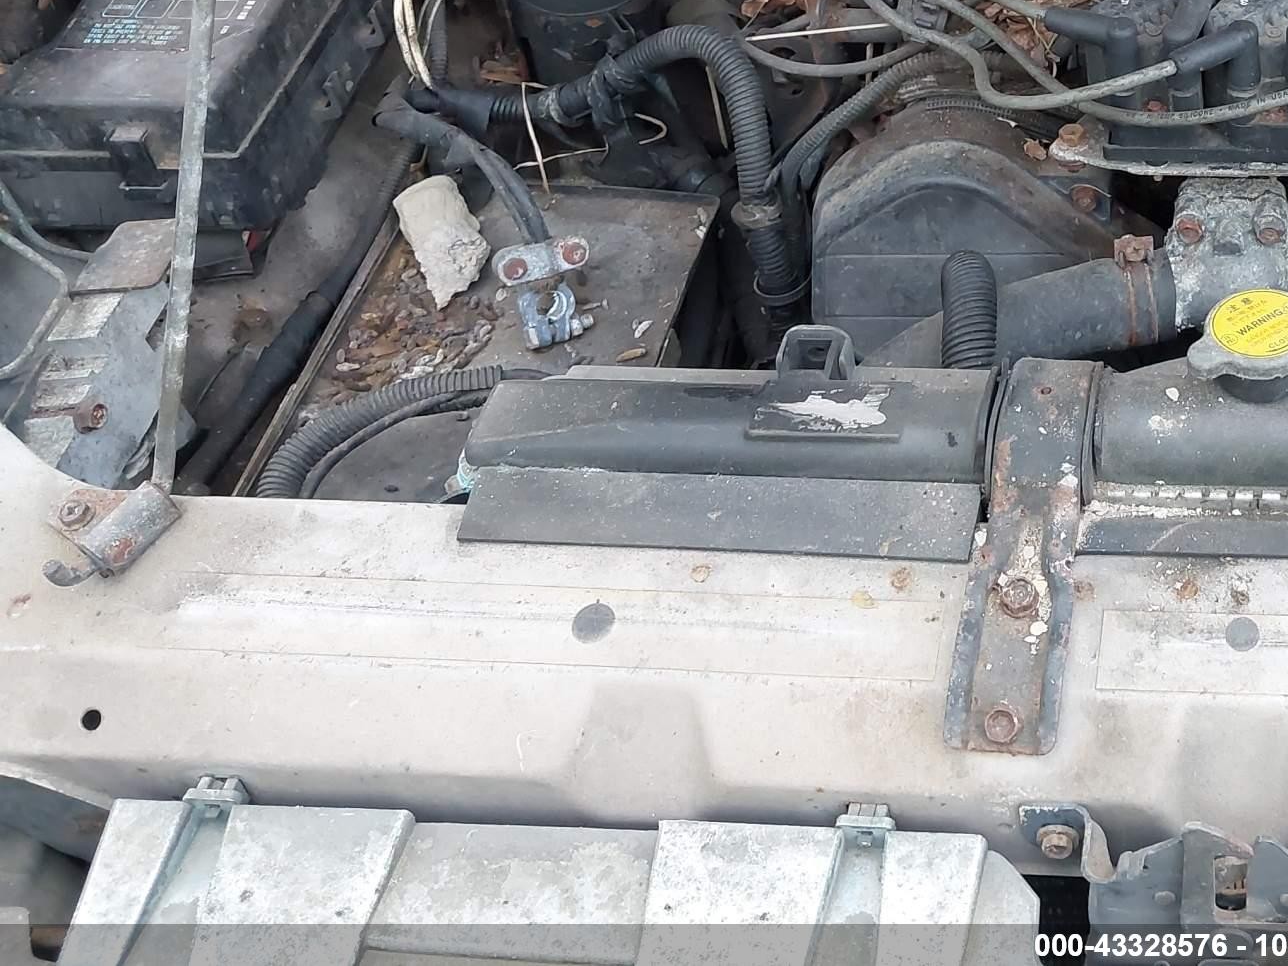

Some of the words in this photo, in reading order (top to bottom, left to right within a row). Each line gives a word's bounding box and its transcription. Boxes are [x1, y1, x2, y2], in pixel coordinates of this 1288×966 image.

[1178, 108, 1215, 120] SILICONE
[1228, 101, 1251, 112] MADE
[1256, 96, 1267, 106] IN
[1236, 308, 1284, 337] WARNING
